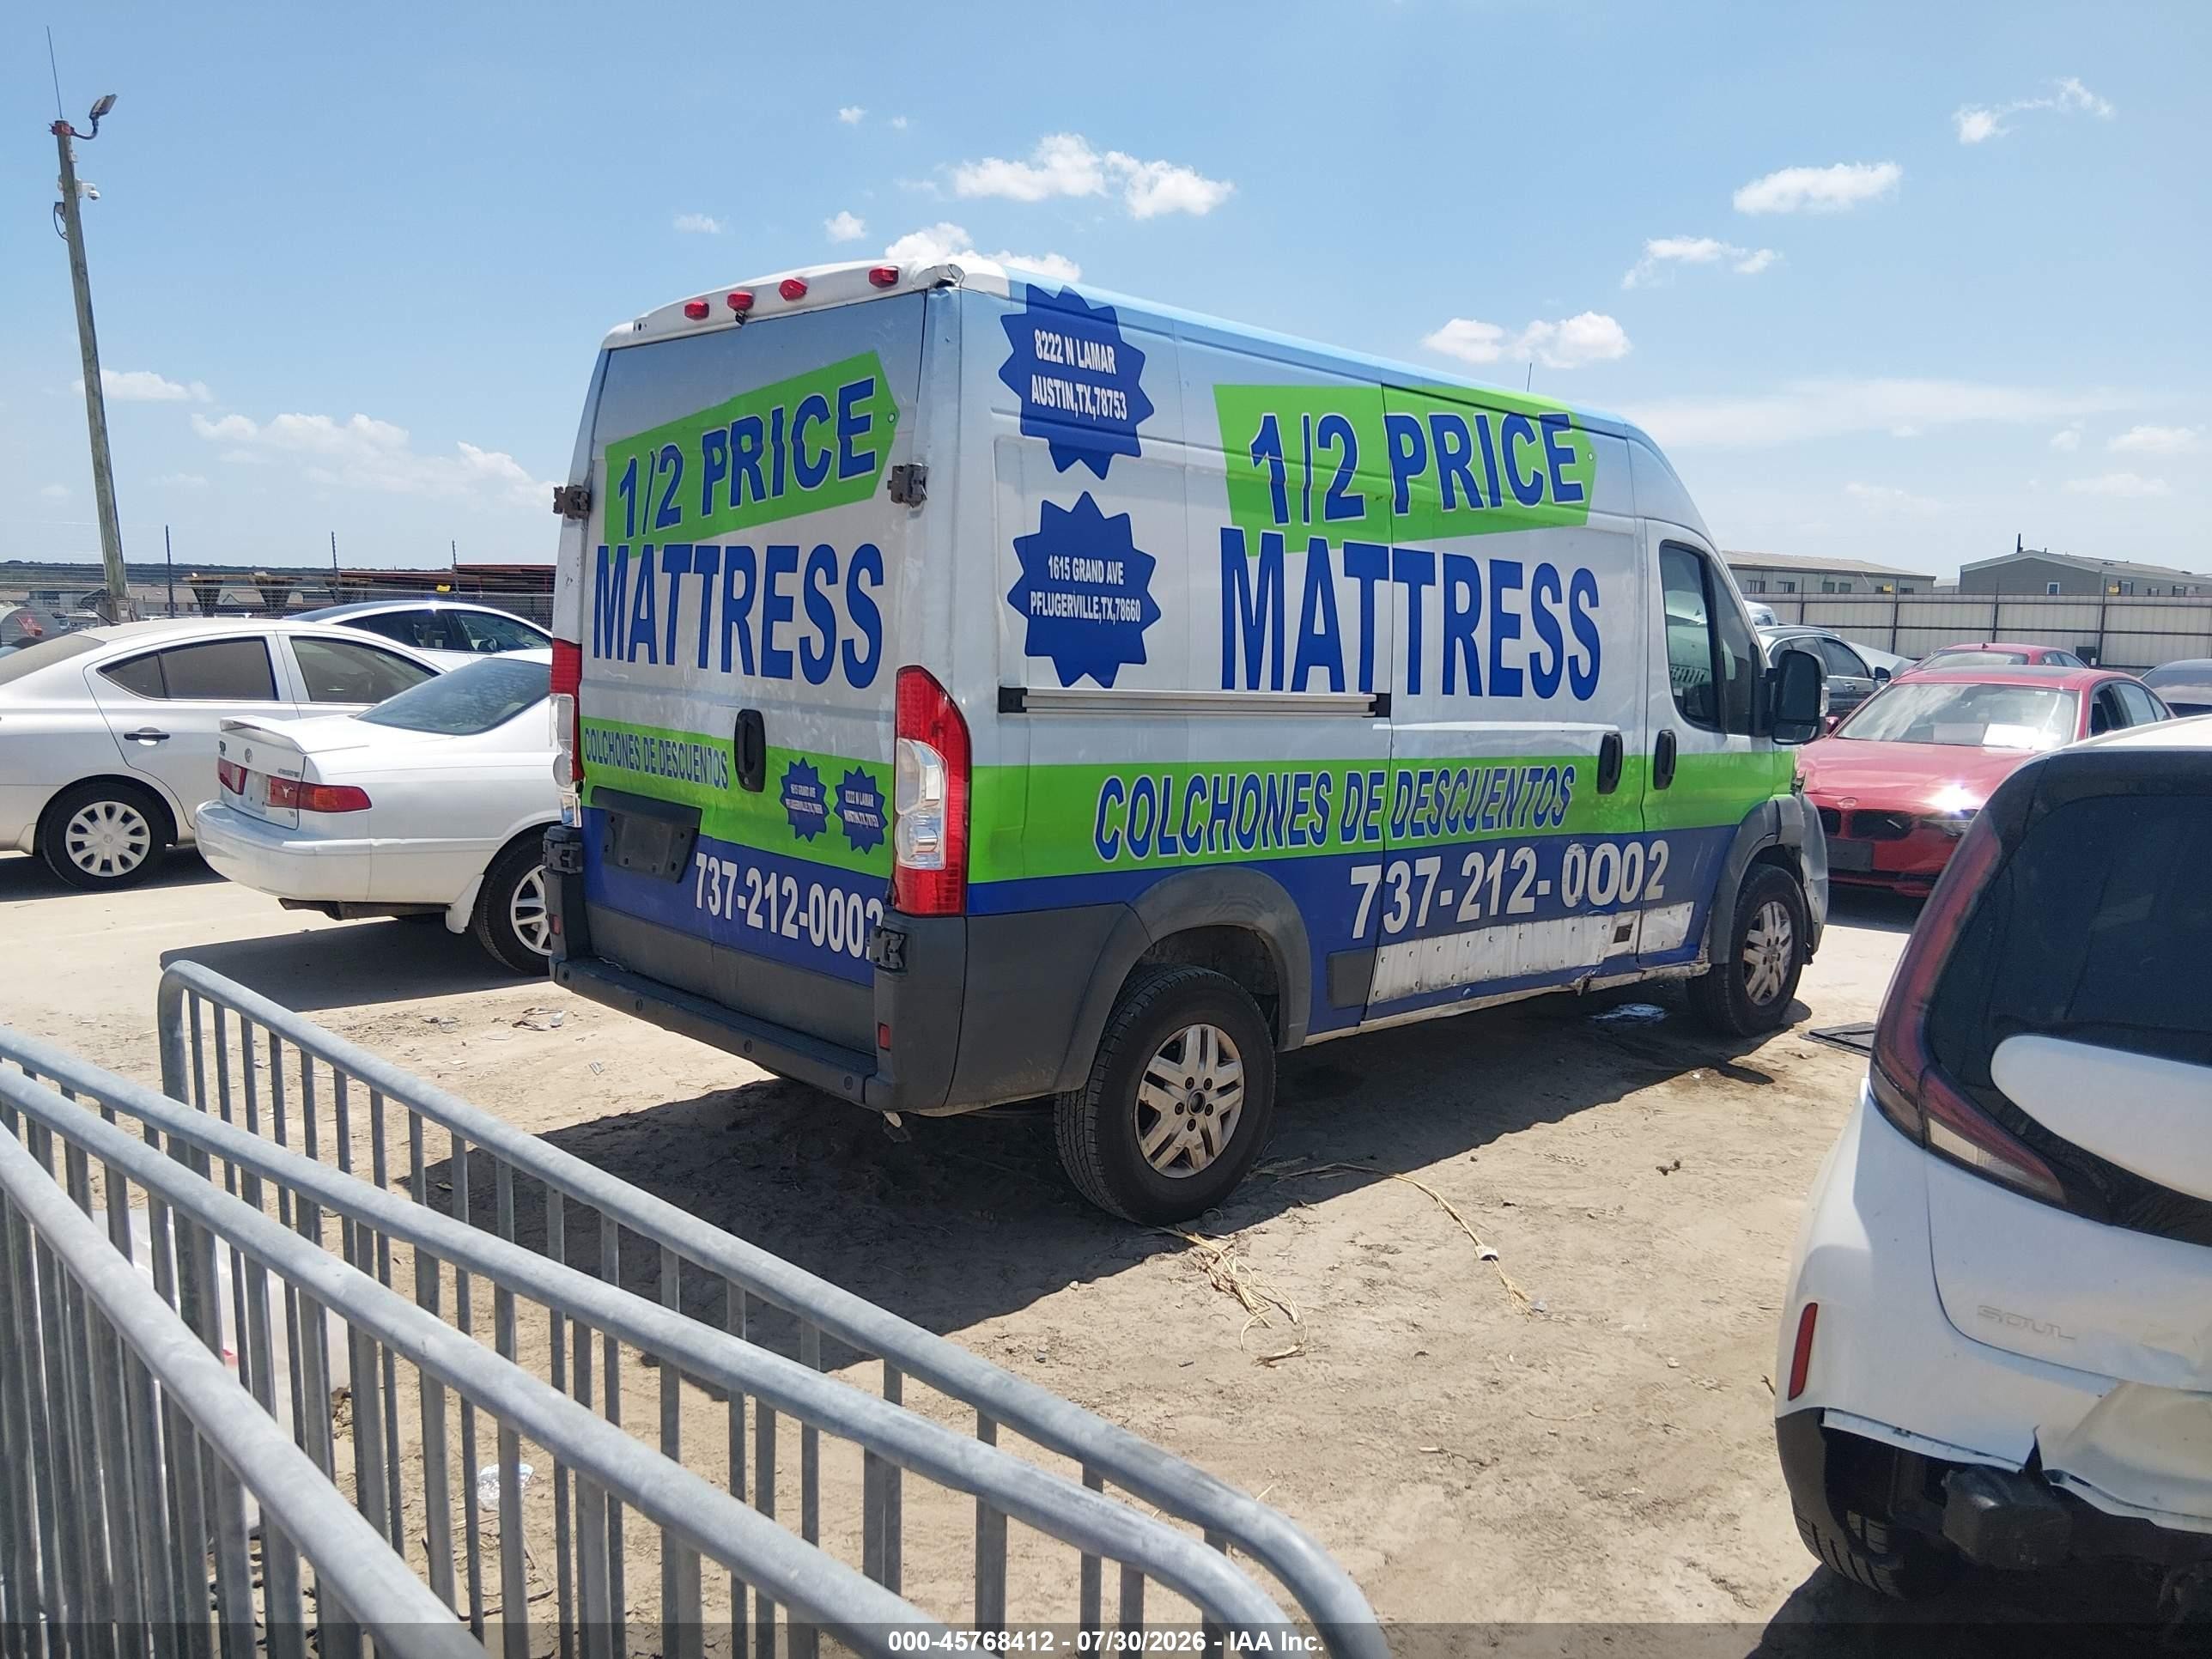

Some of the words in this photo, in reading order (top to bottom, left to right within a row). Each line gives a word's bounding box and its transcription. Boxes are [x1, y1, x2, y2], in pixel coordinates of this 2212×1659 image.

[1031, 374, 1127, 422] AUSTIN,TX,78753
[1034, 329, 1064, 364] 8222
[1065, 336, 1075, 367] N
[1076, 338, 1116, 375] LAMAR
[618, 444, 684, 539] 1/2
[701, 376, 877, 517] PRICE
[1249, 412, 1366, 526] 1/2
[1383, 412, 1584, 517] PRICE
[593, 544, 884, 689] MATTRESS
[1048, 554, 1071, 581] 1615
[1072, 556, 1105, 584] GRAND
[1106, 560, 1125, 586] AVE
[1219, 526, 1601, 701] MATTRESS
[585, 727, 641, 771] COLCHONES
[643, 736, 657, 774] DE
[659, 739, 729, 790] DESCUENTOS
[1093, 770, 1333, 862] COLCHONES
[1340, 769, 1385, 844] DE
[1389, 765, 1575, 841] DESCUENTOS
[1350, 839, 1670, 939] 737-212-0002
[1977, 1304, 2075, 1340] SOUL
